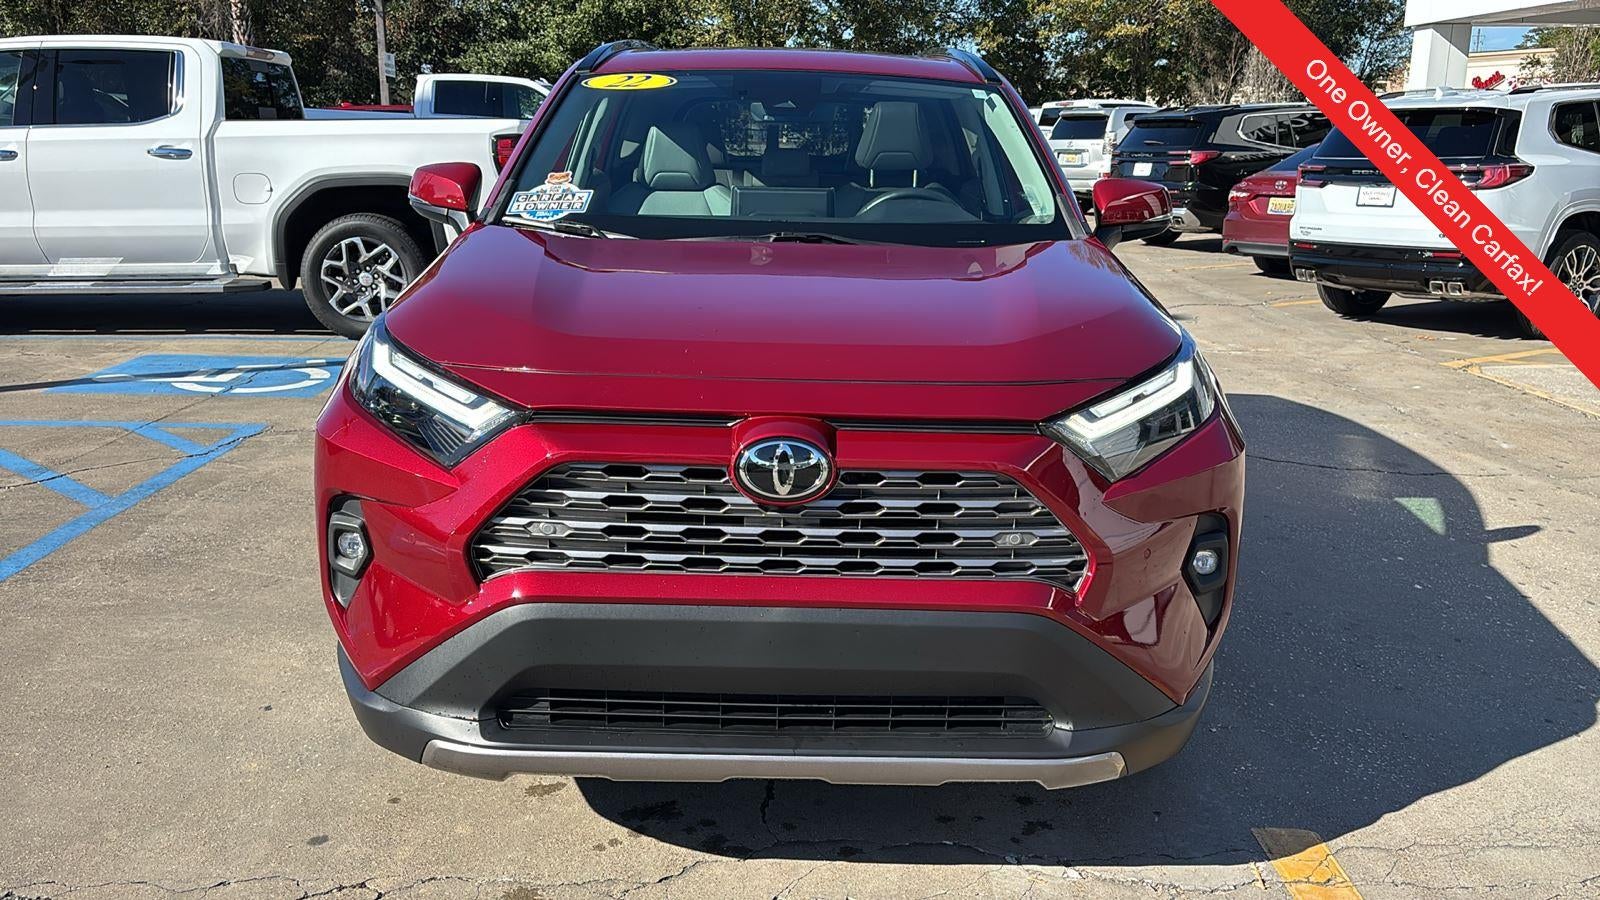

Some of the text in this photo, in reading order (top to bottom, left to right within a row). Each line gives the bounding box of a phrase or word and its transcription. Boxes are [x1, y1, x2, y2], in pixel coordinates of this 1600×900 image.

[606, 75, 652, 88] 22
[517, 192, 585, 202] CARFAX
[515, 201, 584, 211] 1 OWNER
